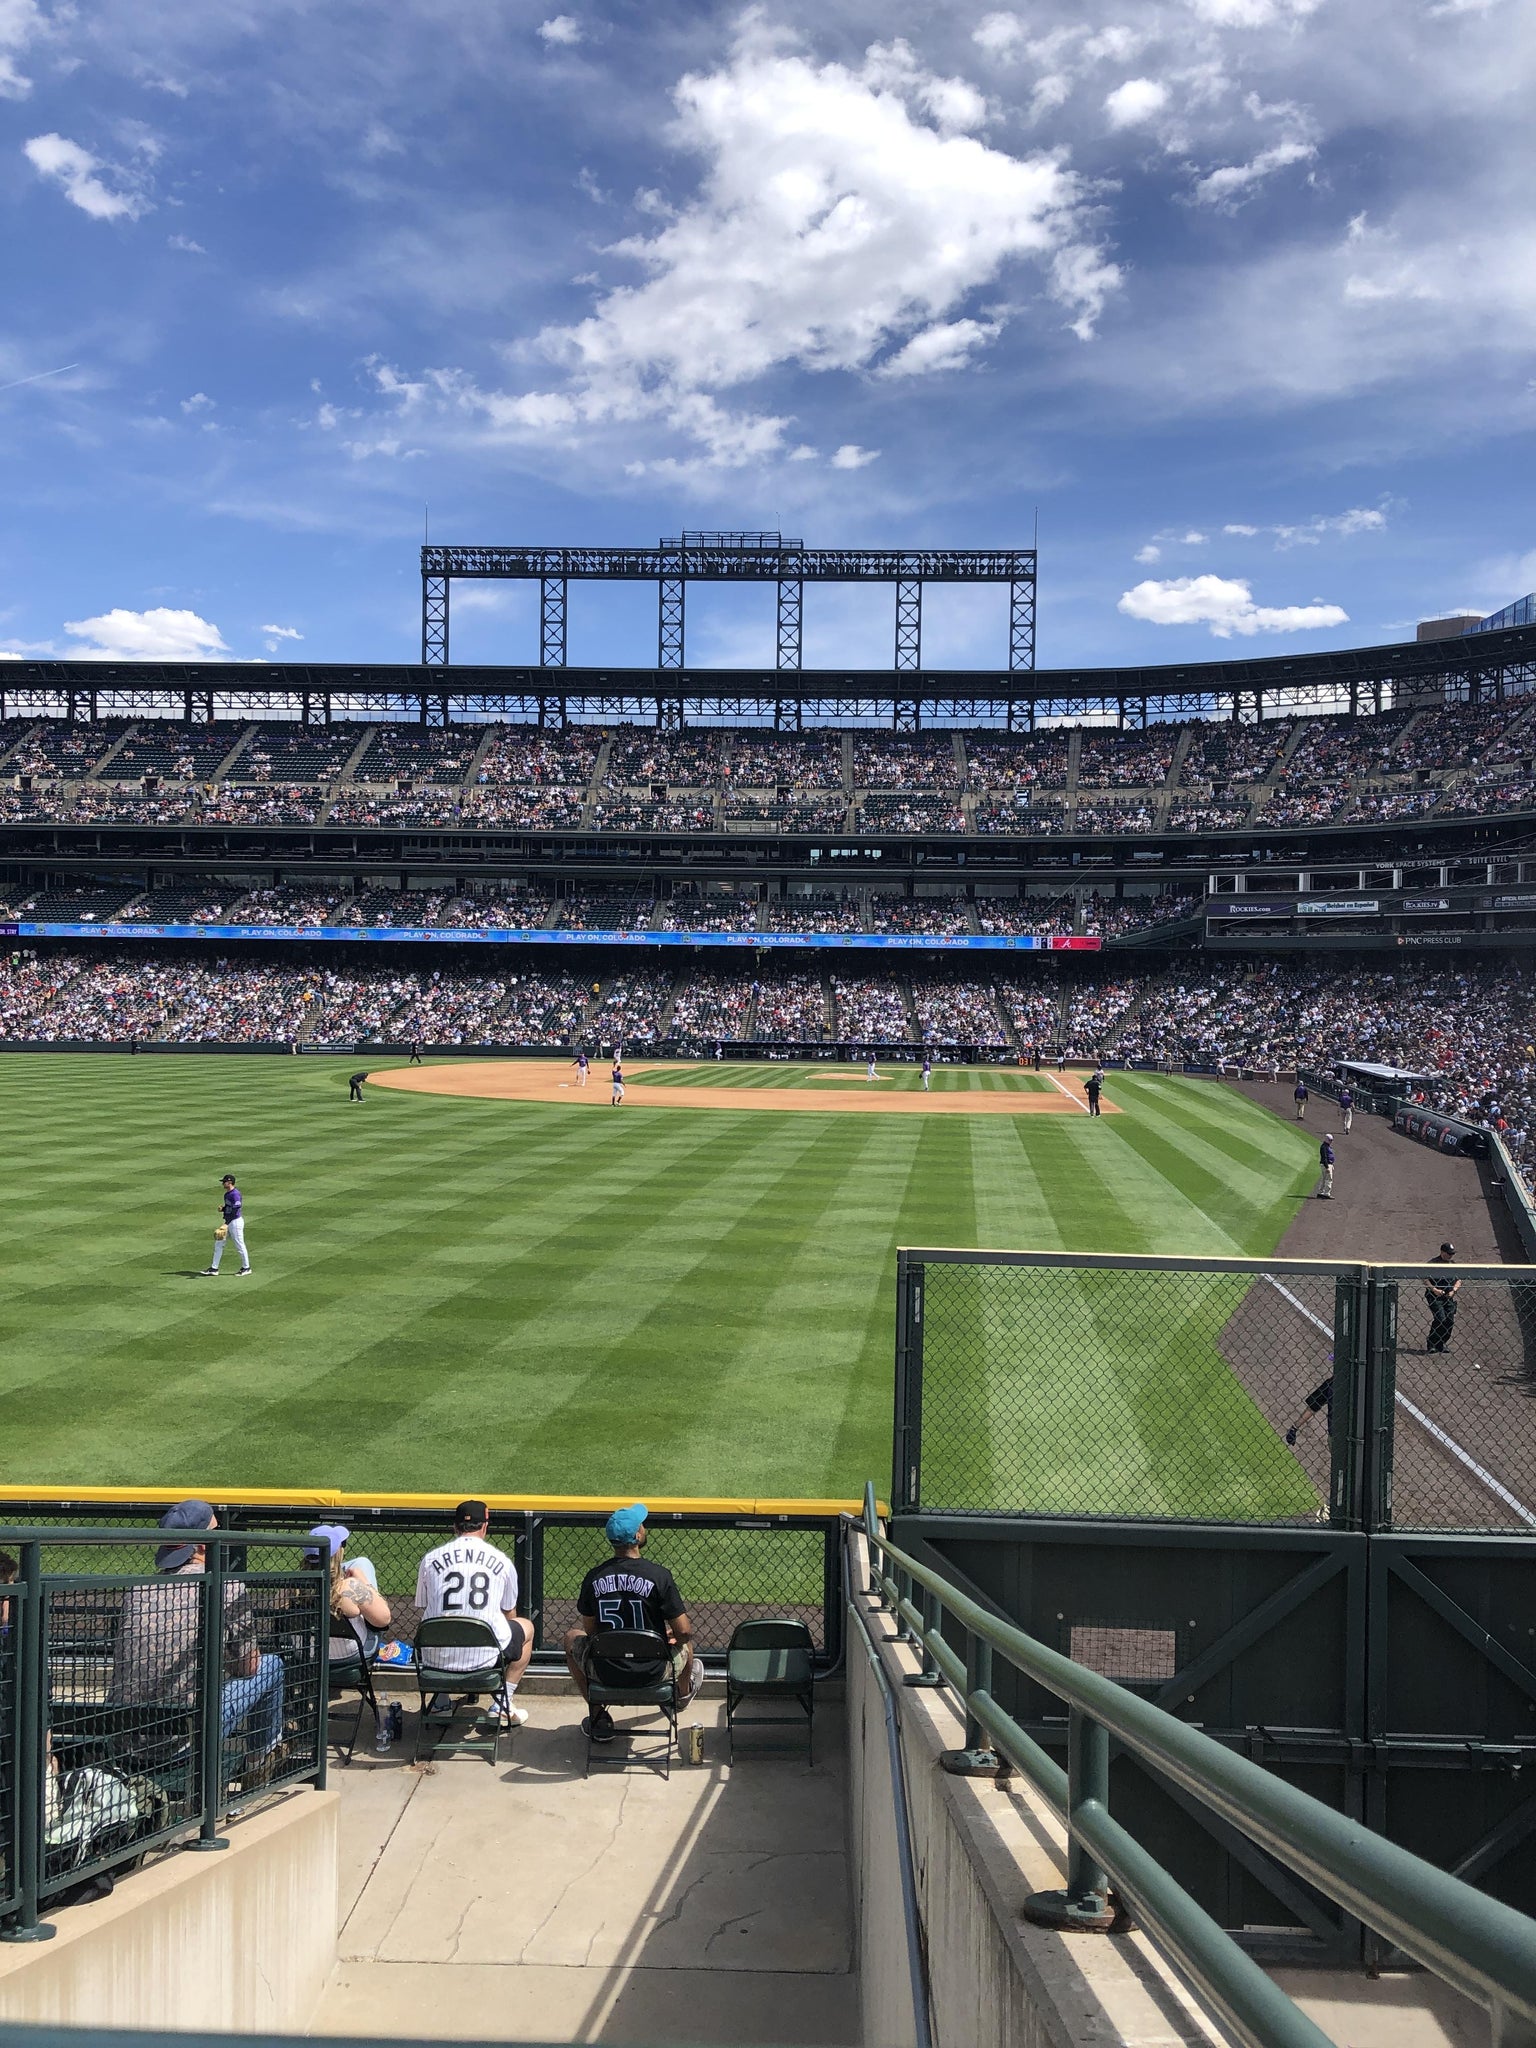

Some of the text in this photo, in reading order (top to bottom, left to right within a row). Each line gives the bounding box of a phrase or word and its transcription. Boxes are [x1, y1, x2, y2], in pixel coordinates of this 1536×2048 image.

[1444, 936, 1462, 944] CLUB
[431, 1548, 504, 1575] ARENADO
[442, 1571, 490, 1611] 28
[592, 1574, 655, 1598] JOHNSON
[598, 1599, 645, 1630] 51
